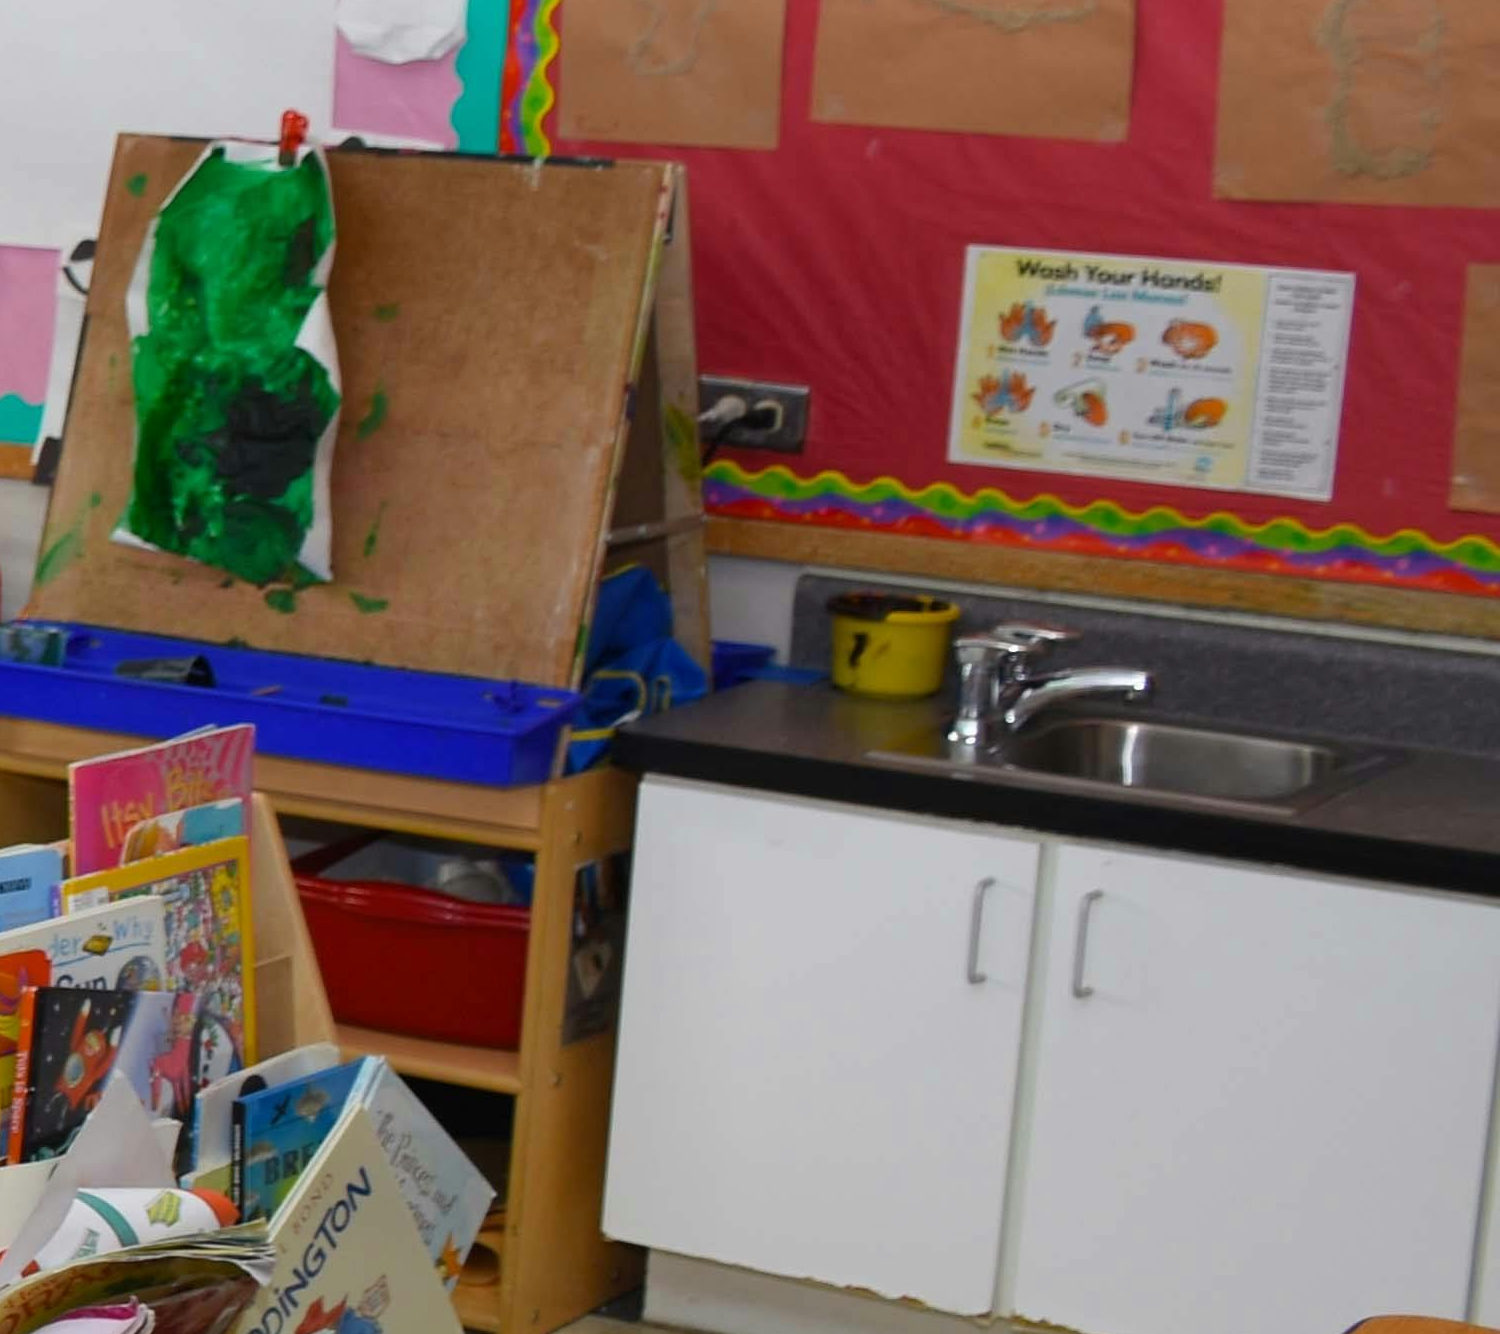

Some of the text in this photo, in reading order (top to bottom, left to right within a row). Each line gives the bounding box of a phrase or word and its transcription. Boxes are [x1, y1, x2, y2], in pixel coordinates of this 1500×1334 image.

[1016, 258, 1223, 293] Wash Your Hands!
[114, 916, 154, 941] Why
